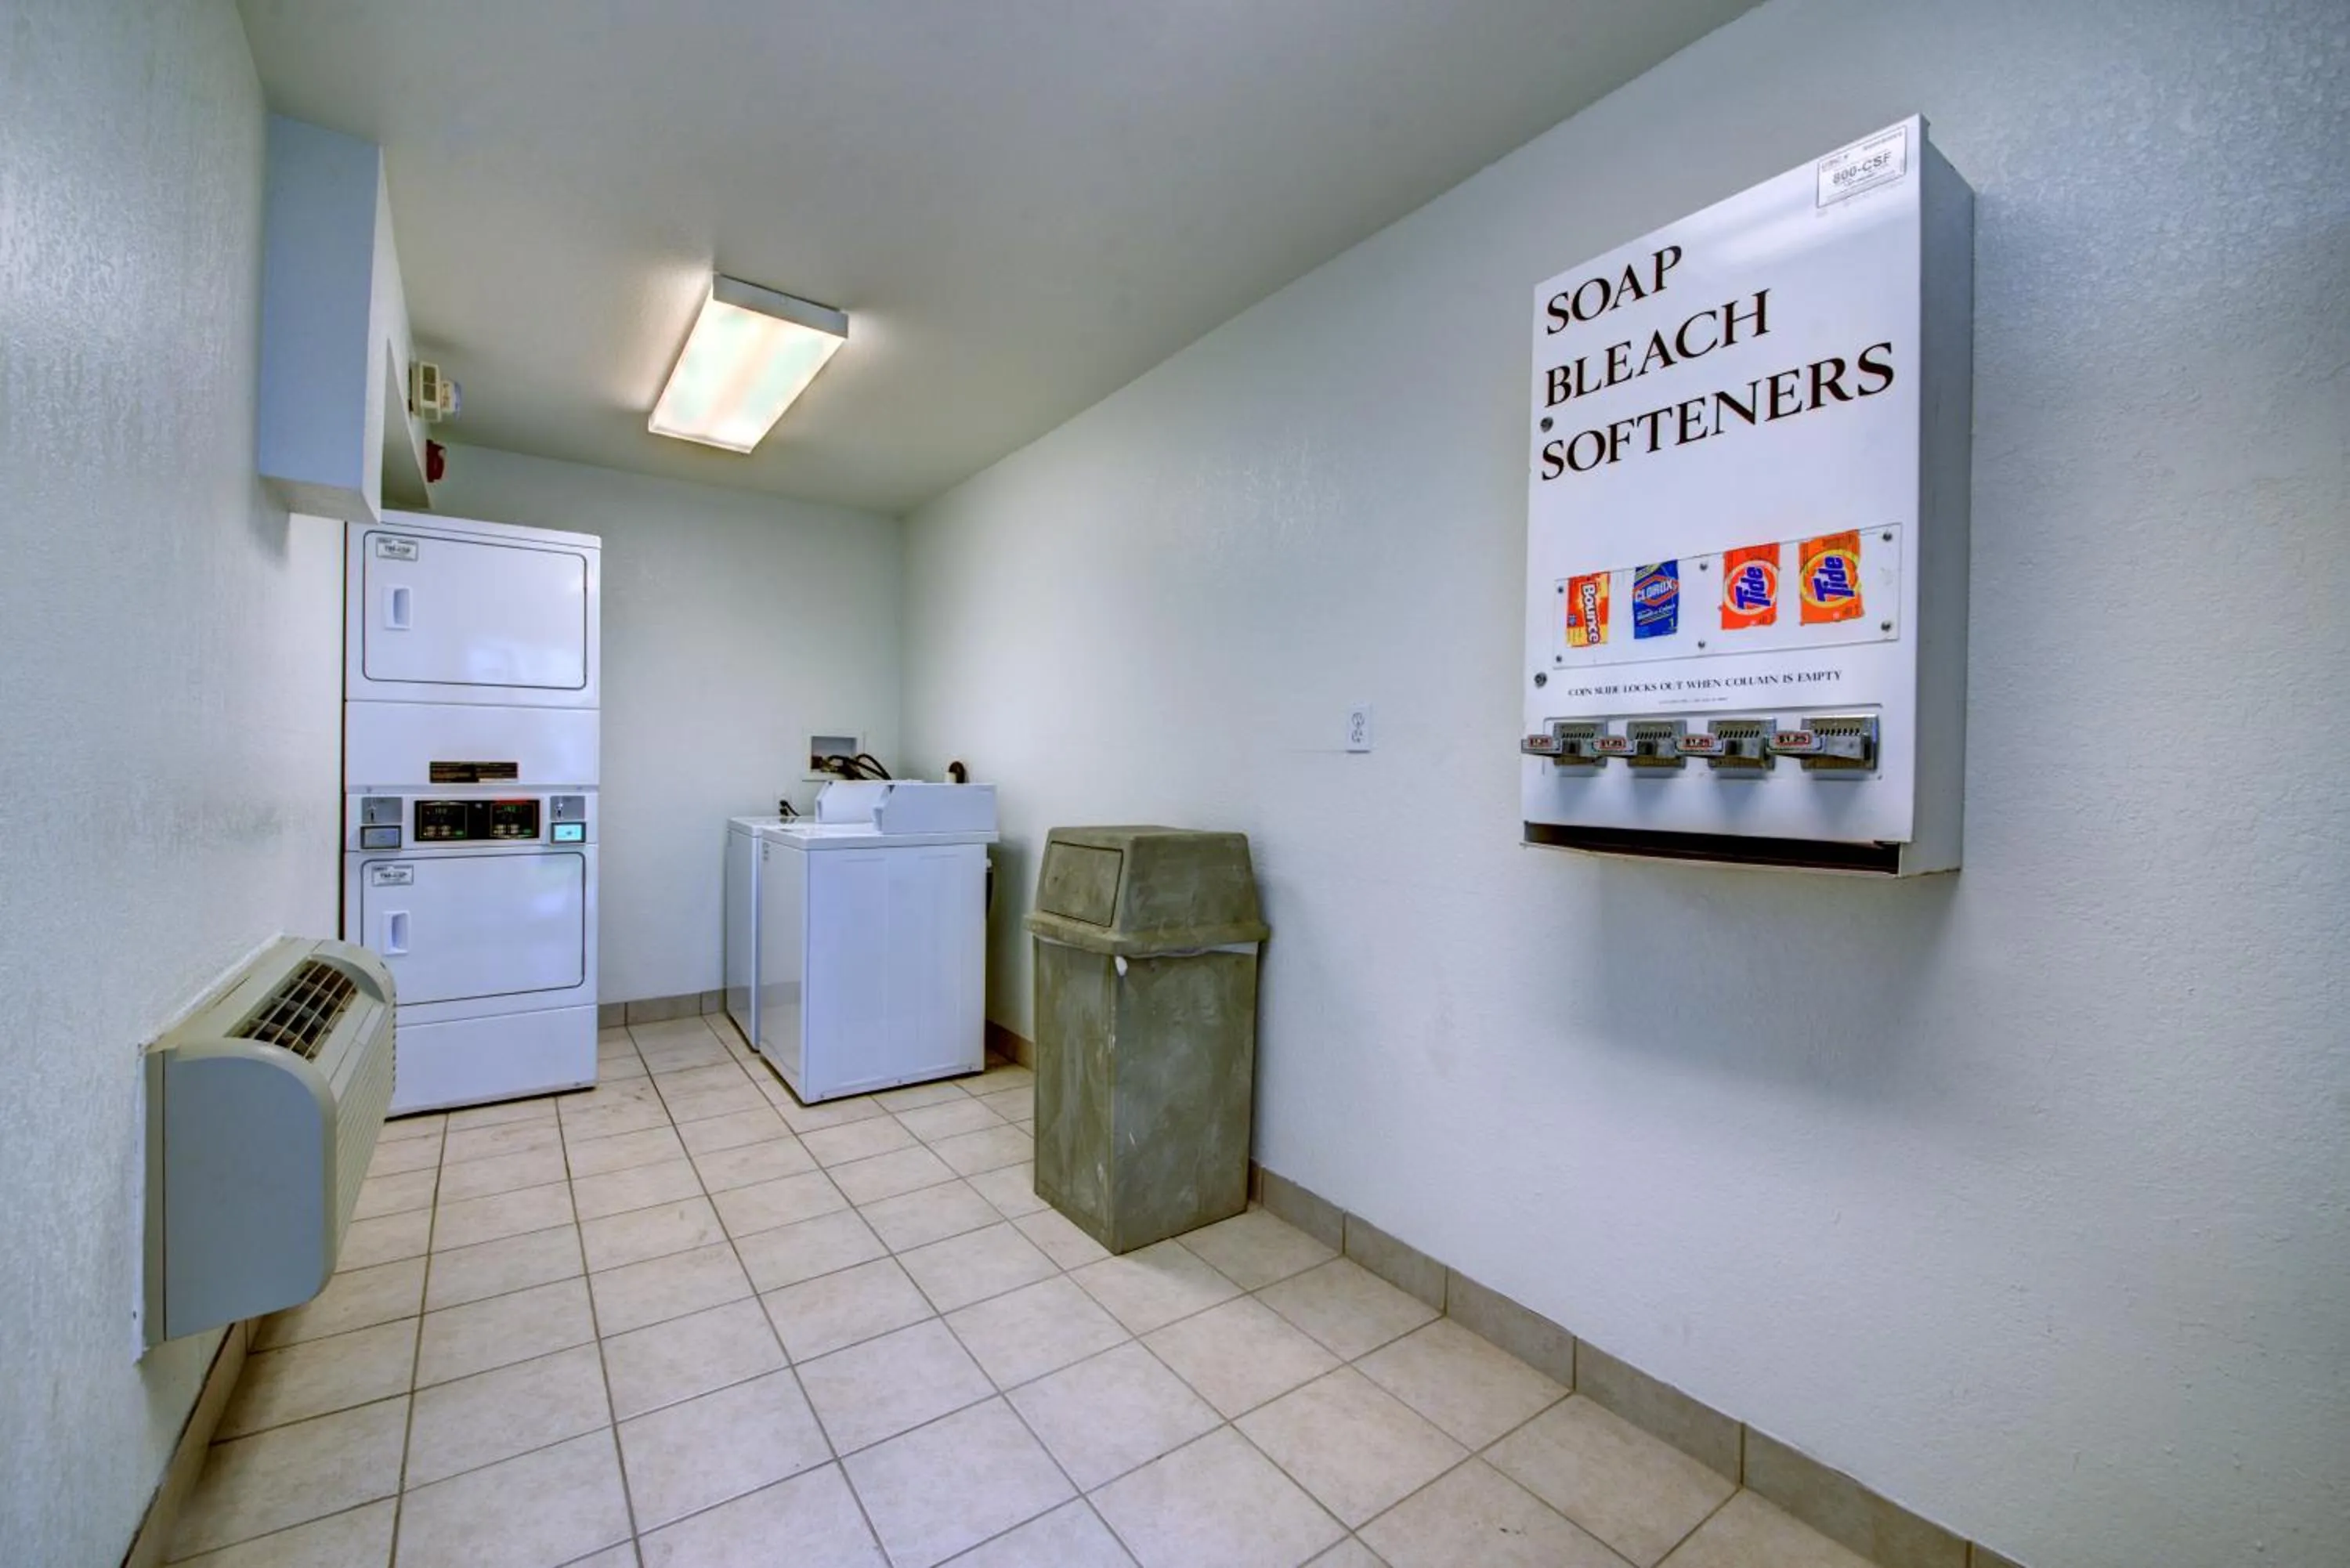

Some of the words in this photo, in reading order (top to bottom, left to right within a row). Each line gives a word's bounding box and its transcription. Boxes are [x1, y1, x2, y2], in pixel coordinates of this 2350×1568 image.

[1832, 150, 1892, 184] 800-CSF
[1546, 244, 1682, 335] SOAP
[1545, 288, 1770, 407] BLEACH
[1541, 341, 1894, 481] SOFTENERS
[1634, 579, 1674, 603] CLOROX
[1735, 566, 1770, 609] Tide
[1813, 556, 1854, 602] Tide
[1582, 583, 1600, 644] Bounce
[1567, 688, 1593, 696] COIN
[1595, 685, 1618, 695] SLIDE
[1623, 683, 1657, 693] LOCKS
[1660, 681, 1683, 690] OUT
[1687, 678, 1722, 689] WHEN
[1725, 675, 1778, 687] COLUMN
[1783, 673, 1794, 683] IS
[1798, 670, 1842, 682] EMPTY
